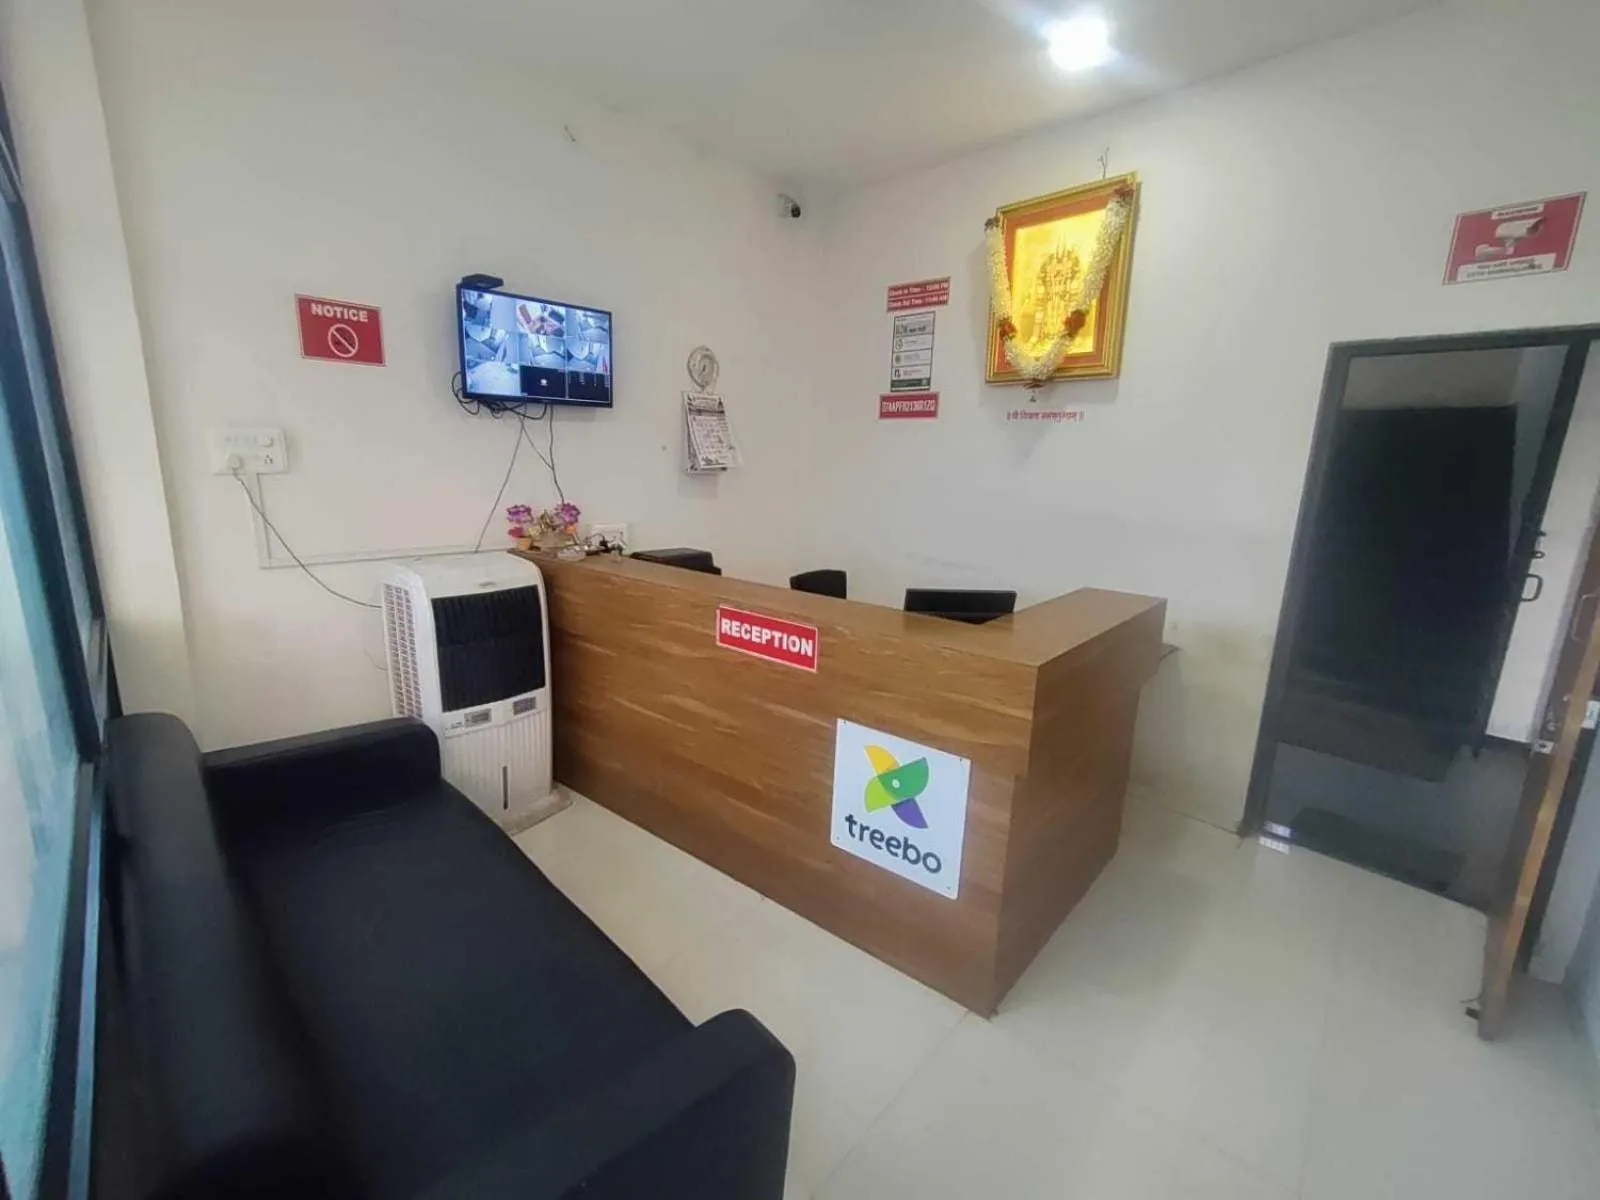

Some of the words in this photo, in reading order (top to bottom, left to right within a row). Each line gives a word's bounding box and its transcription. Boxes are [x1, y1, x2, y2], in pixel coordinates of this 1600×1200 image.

[311, 303, 368, 322] NOTICE
[721, 618, 813, 657] RECEPTION
[844, 813, 942, 874] treebo
